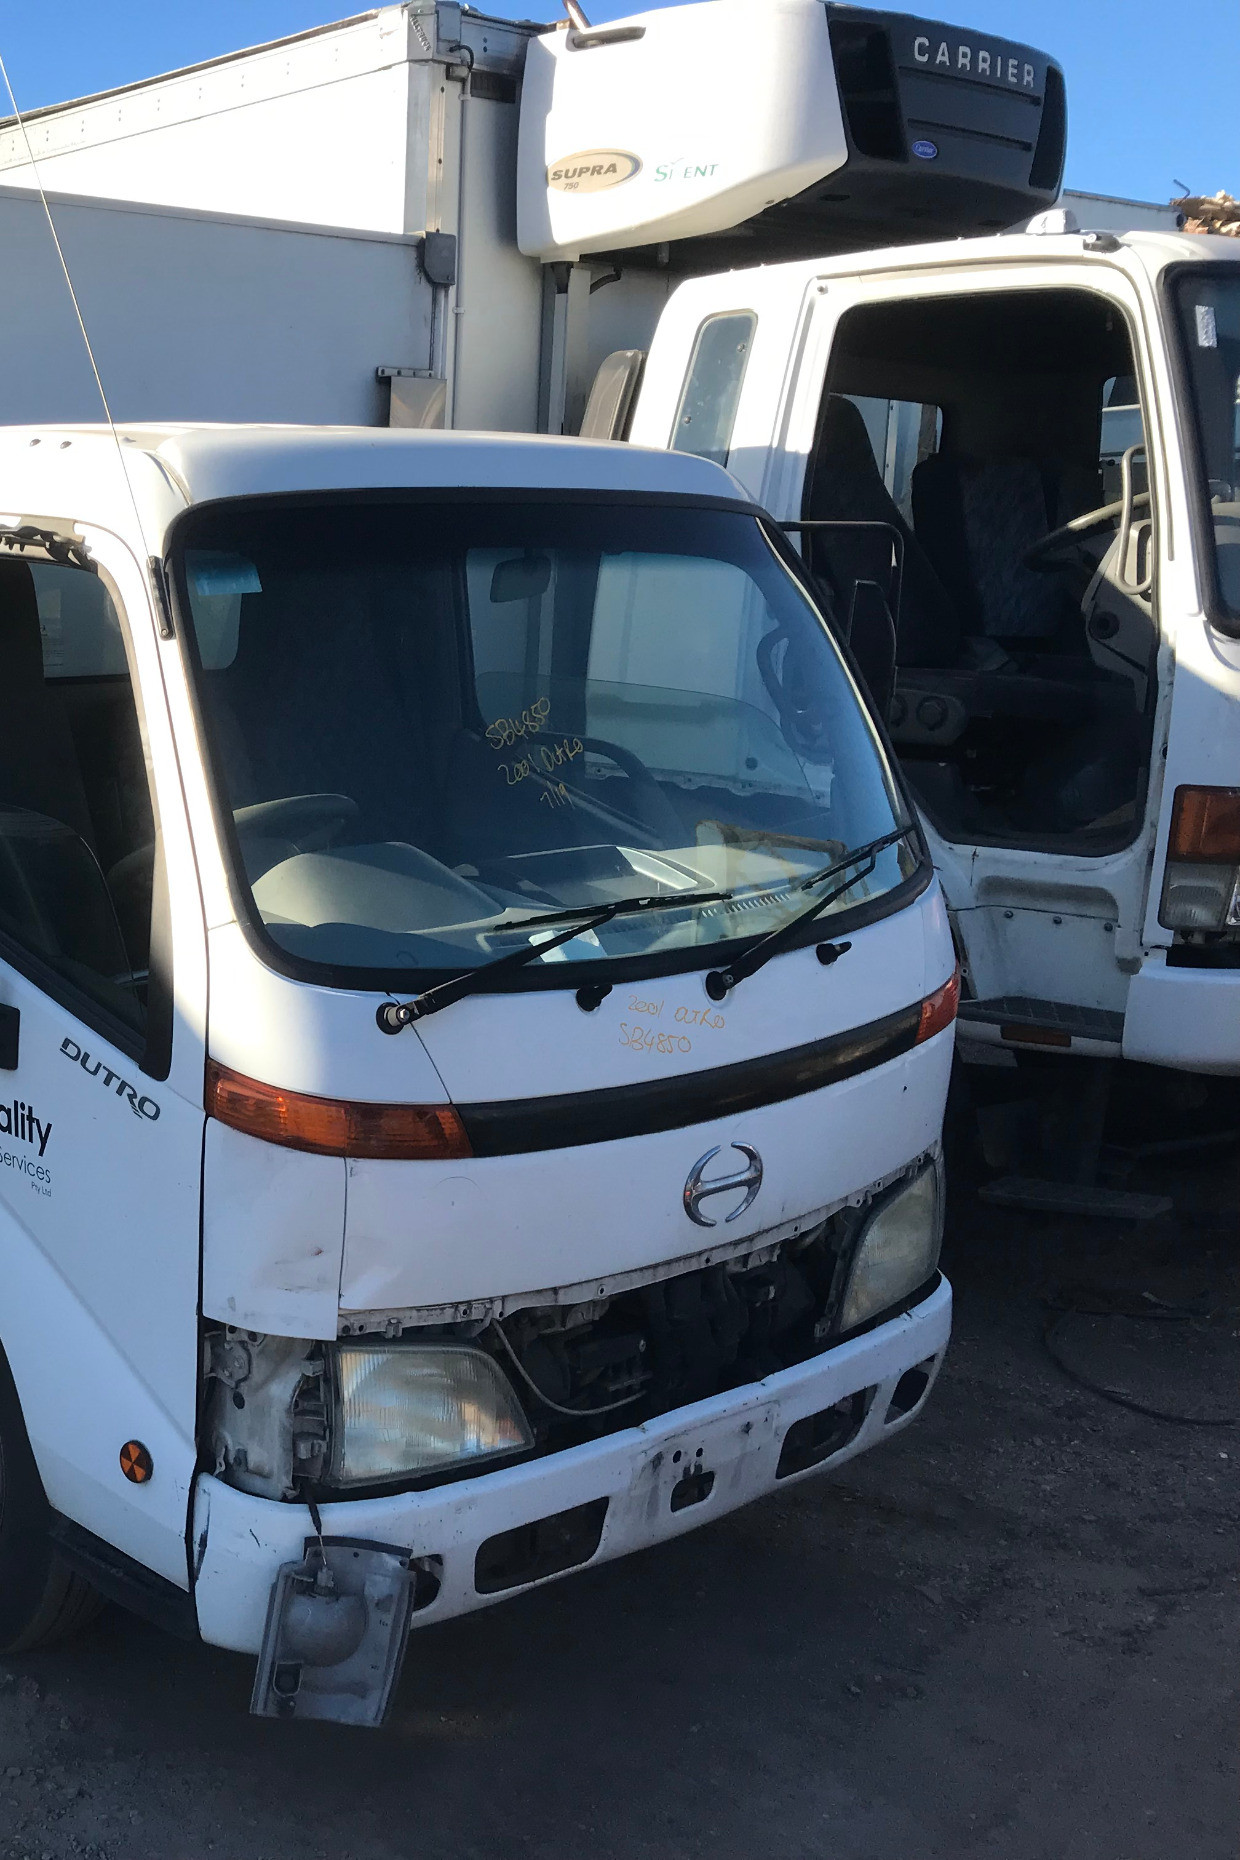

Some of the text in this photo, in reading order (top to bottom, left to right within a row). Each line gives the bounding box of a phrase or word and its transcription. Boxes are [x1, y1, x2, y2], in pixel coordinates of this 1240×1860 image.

[914, 36, 1035, 88] CARRIER
[551, 162, 618, 181] SUPRA
[563, 182, 580, 191] 750
[618, 1022, 692, 1054] SB4850
[59, 1037, 161, 1121] DUTRO
